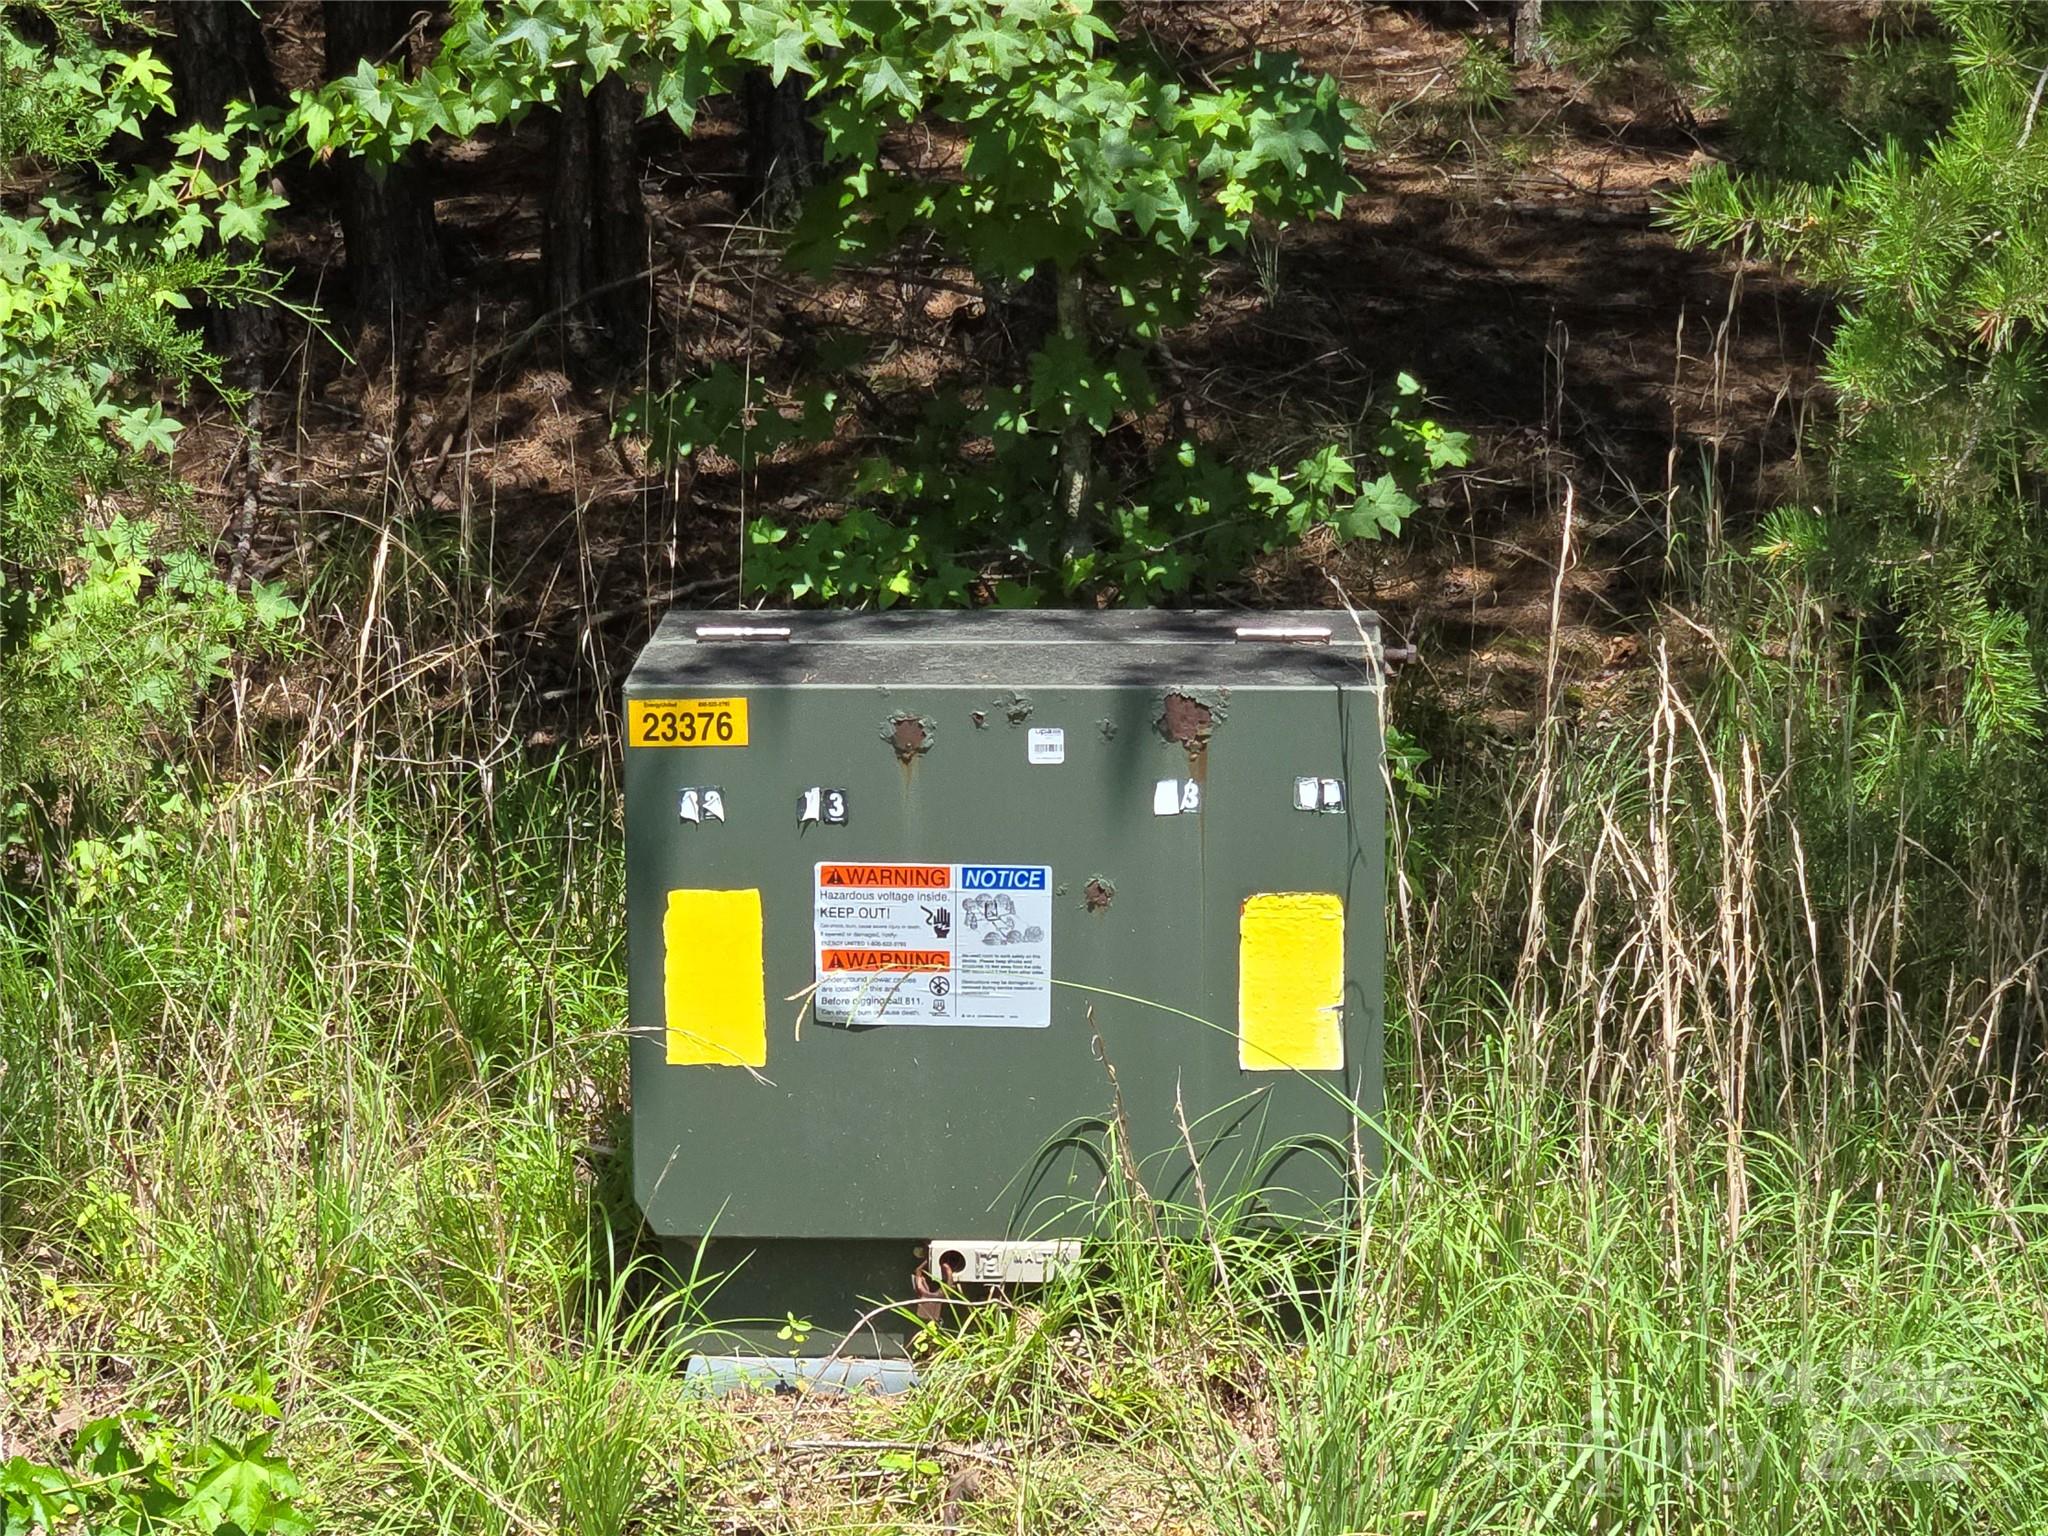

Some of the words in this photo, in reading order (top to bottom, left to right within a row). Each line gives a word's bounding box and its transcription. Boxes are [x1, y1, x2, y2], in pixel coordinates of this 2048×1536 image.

[642, 711, 734, 742] 23376
[845, 868, 946, 886] WARNING
[965, 869, 1042, 888] NOTICE
[820, 890, 875, 901] Hazardous
[877, 891, 914, 903] voltage
[917, 891, 951, 902] inside.
[820, 906, 855, 918] KEEP
[858, 906, 891, 919] OUT!
[845, 952, 946, 970] WARNING
[821, 996, 850, 1005] Before
[852, 996, 885, 1007] dgging
